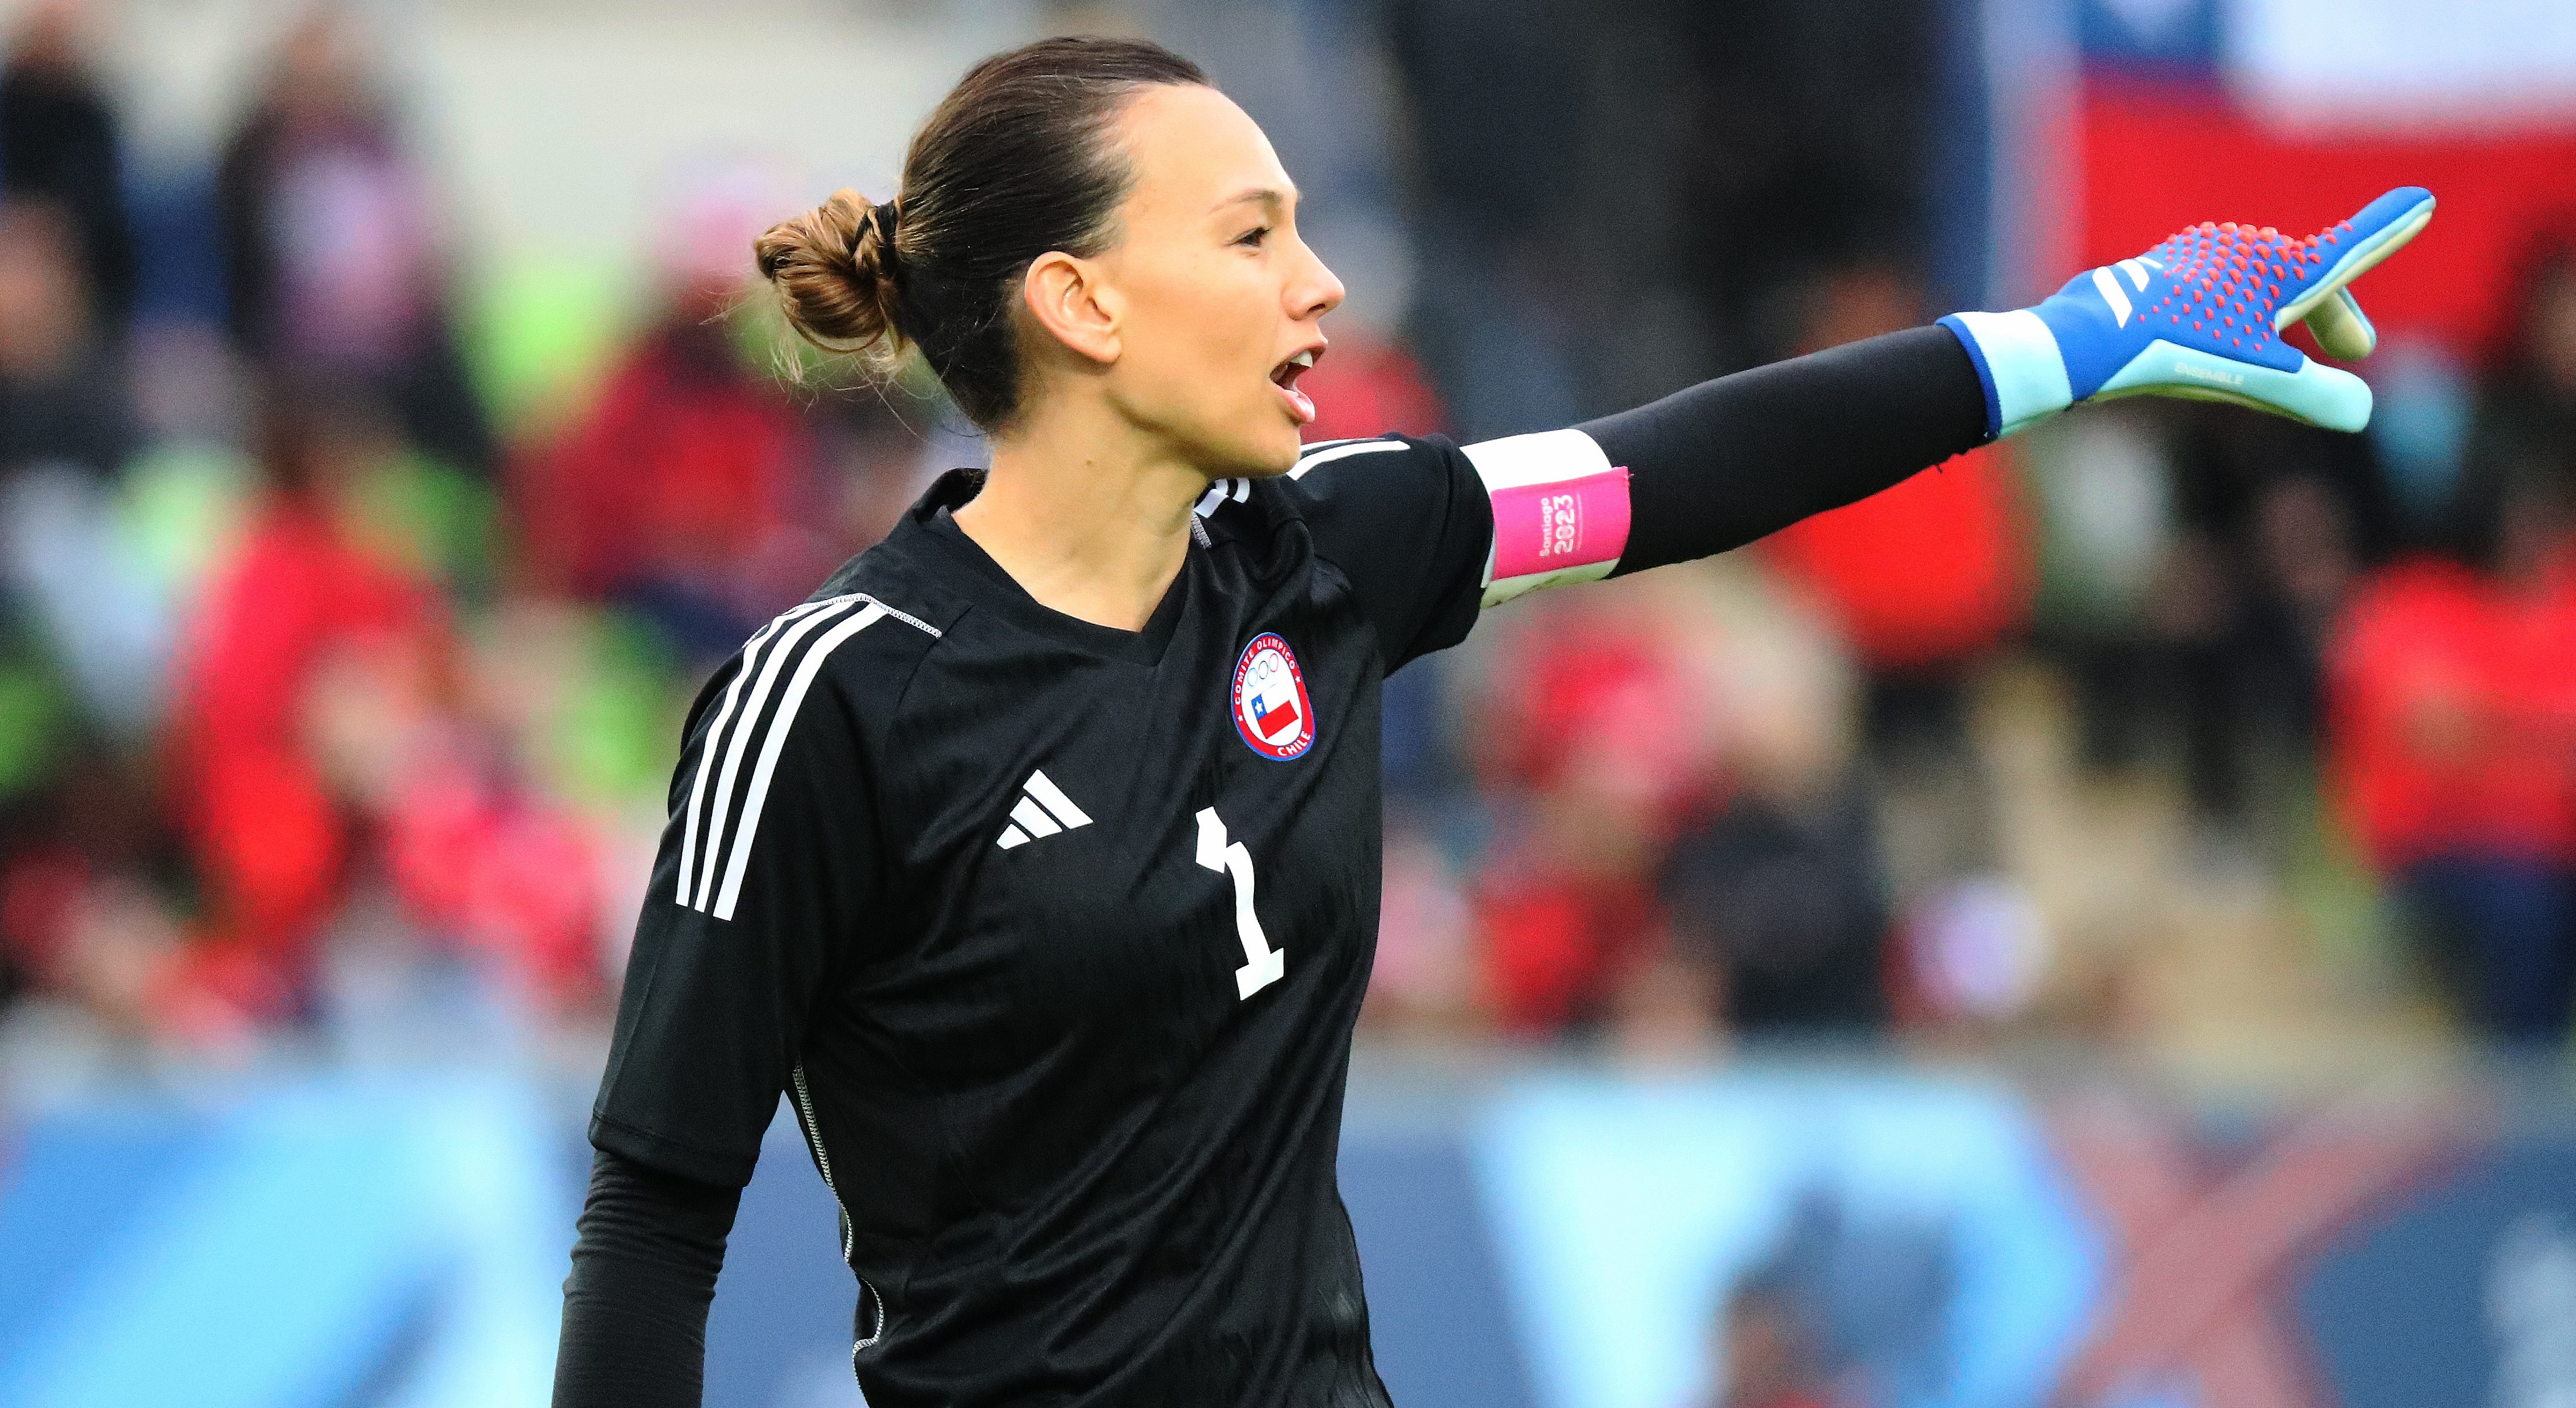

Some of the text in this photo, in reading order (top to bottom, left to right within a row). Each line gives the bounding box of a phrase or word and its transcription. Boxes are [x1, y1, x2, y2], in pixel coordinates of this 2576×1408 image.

[1539, 497, 1553, 557] Santiago
[1553, 494, 1575, 554] 2023
[1235, 638, 1296, 705] COMITE OLIMPICO
[1277, 730, 1311, 756] CHILE
[1195, 806, 1283, 1001] 1
